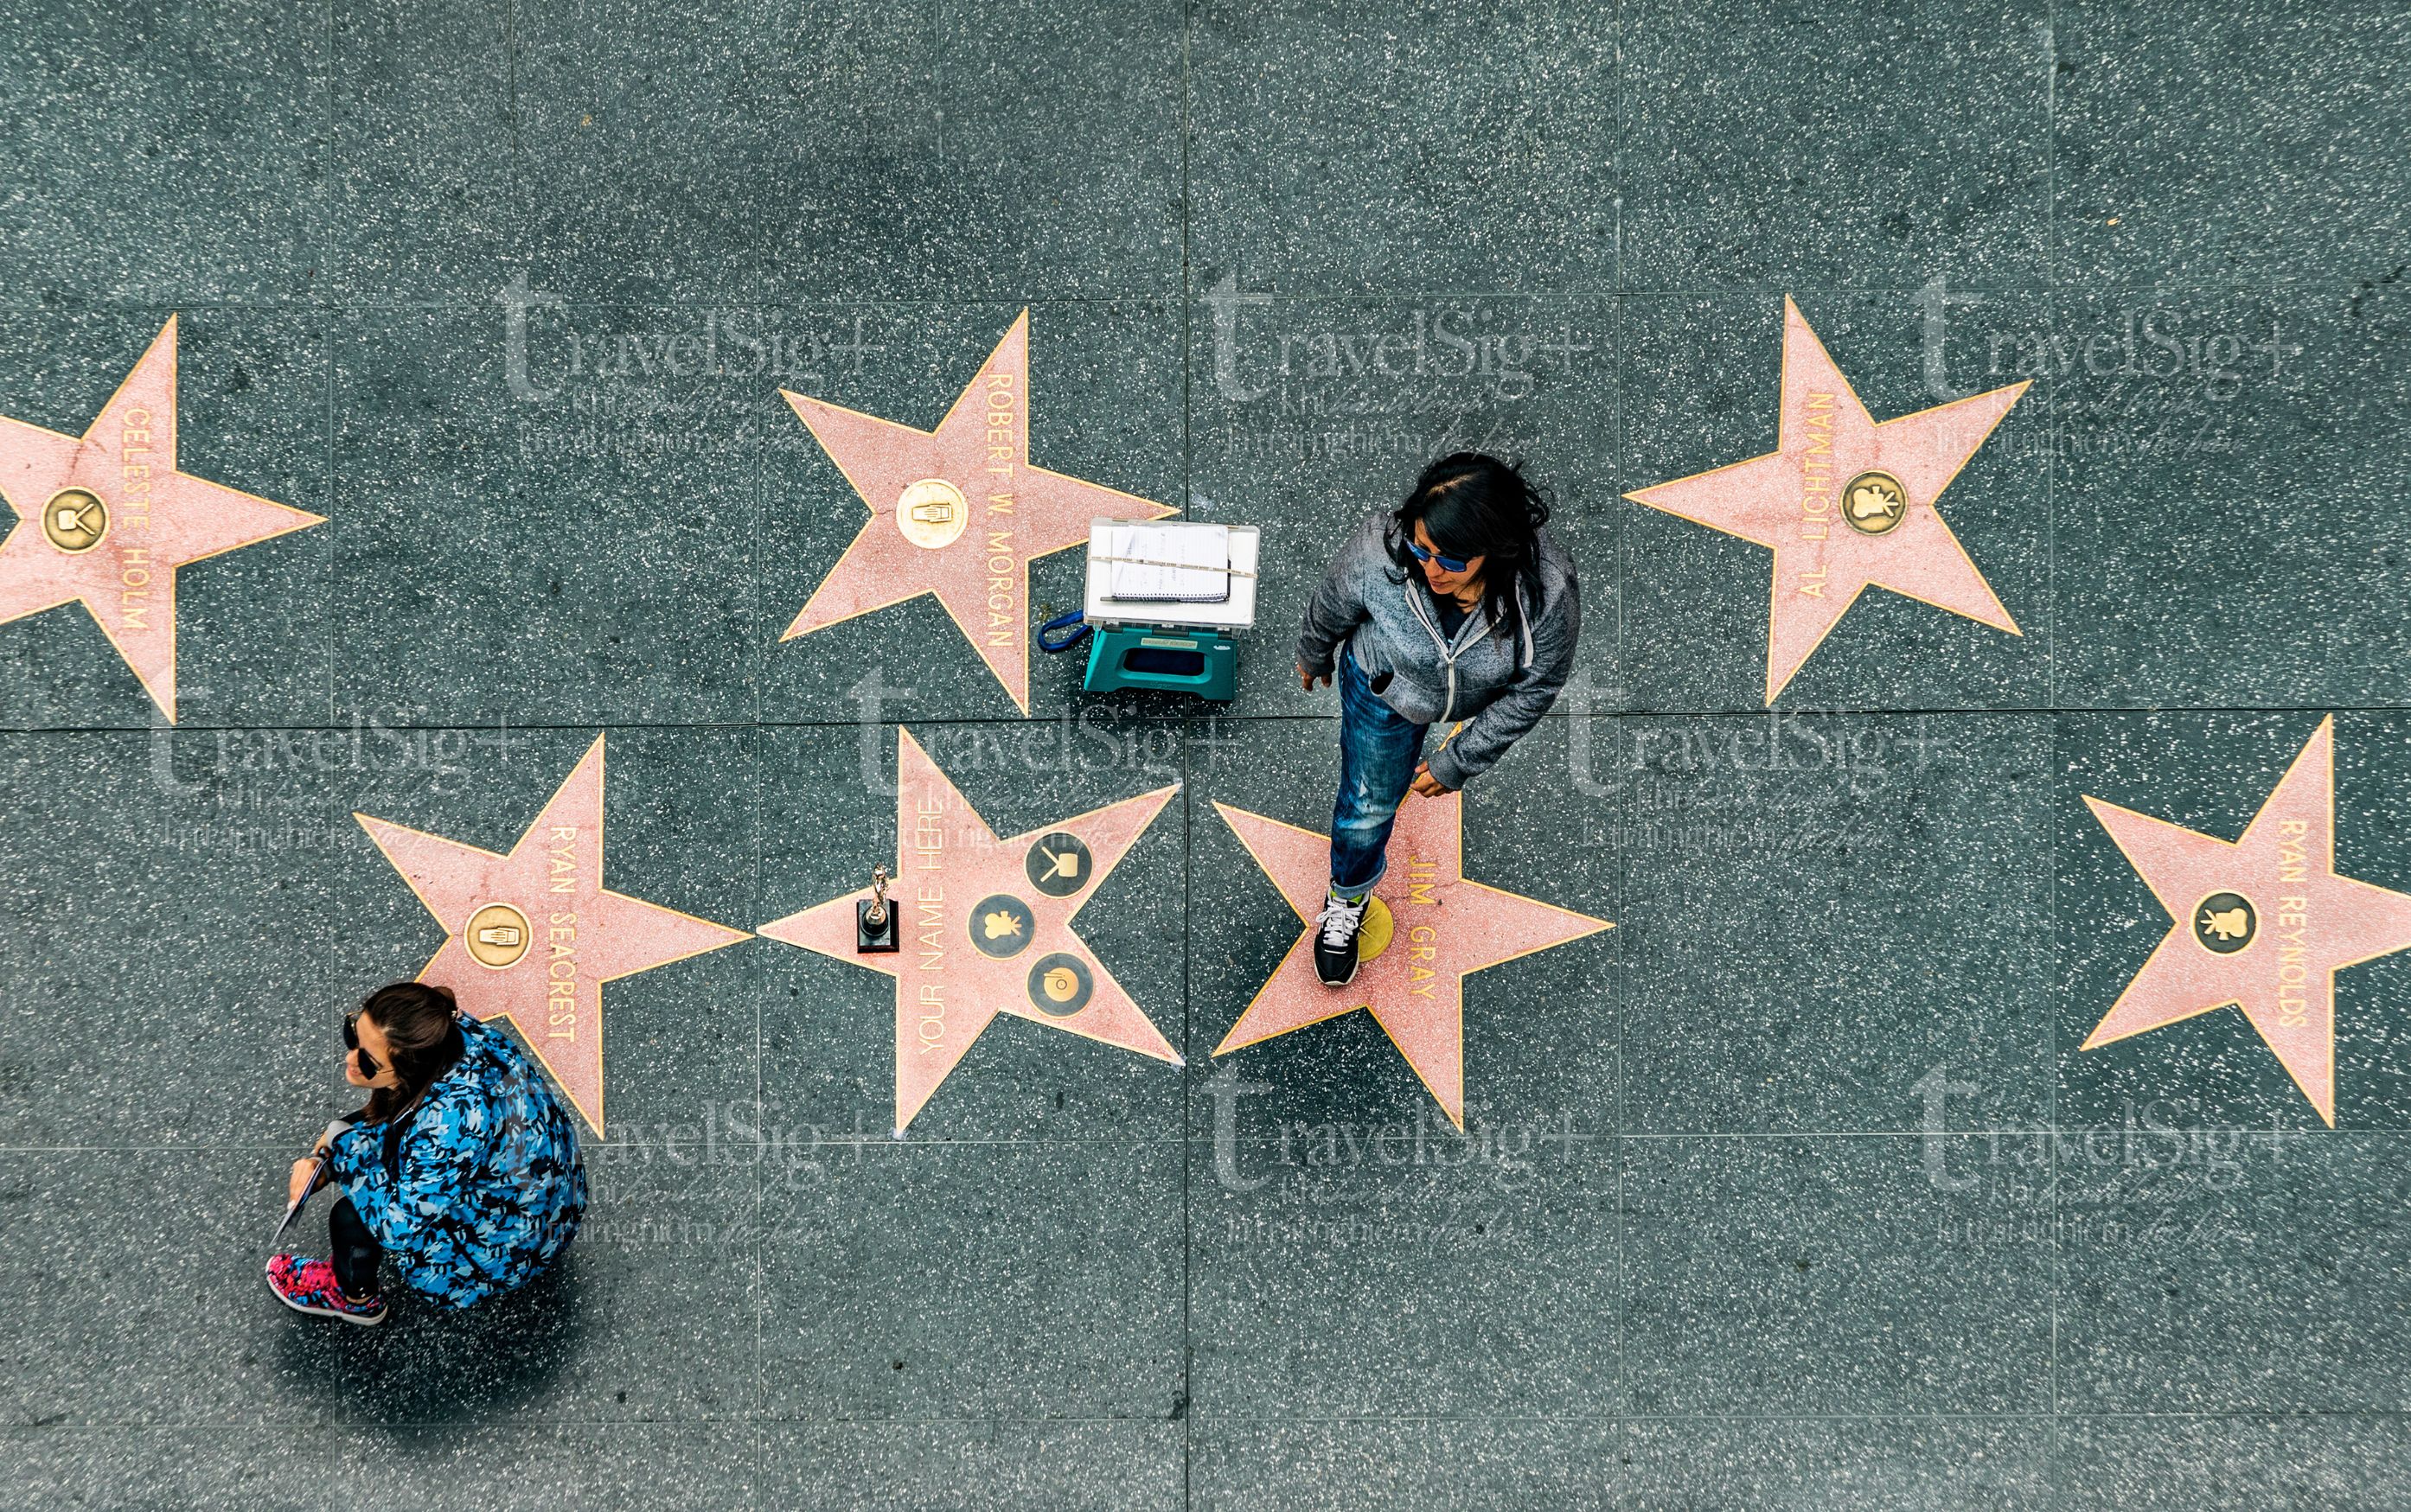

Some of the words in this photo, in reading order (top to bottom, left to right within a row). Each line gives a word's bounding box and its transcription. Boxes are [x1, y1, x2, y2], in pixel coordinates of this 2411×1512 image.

[988, 373, 1014, 477] ROBERT
[123, 408, 150, 530] CELESTE
[988, 493, 1014, 515] W.
[1802, 393, 1834, 539] LICHTMAN
[121, 549, 150, 628] HOLM
[988, 533, 1015, 648] MORGAN
[1799, 565, 1827, 598] AL
[549, 826, 579, 893] RYAN
[918, 799, 943, 871] HERE
[2278, 820, 2307, 883] RYAN
[1409, 855, 1436, 904] JIM
[918, 886, 944, 971] NAME
[1410, 927, 1436, 1000] GRAY
[2278, 896, 2308, 1029] REYNOLDS
[548, 913, 578, 1043] SEACREST
[918, 983, 945, 1056] YOUR
